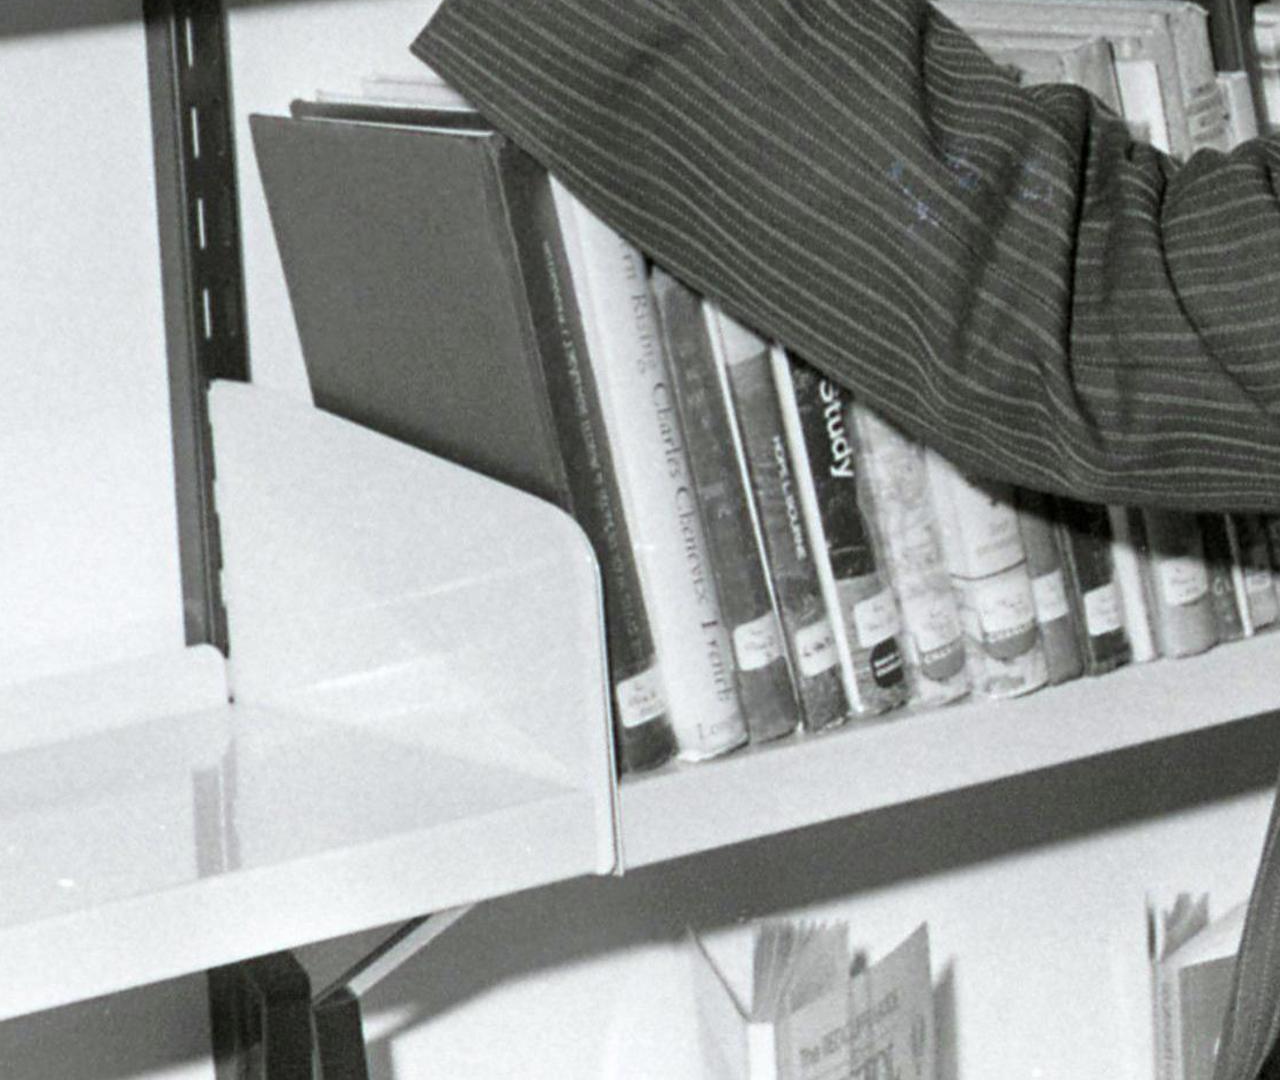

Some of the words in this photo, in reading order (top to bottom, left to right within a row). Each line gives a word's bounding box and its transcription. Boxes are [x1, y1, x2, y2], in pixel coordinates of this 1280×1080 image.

[652, 381, 684, 478] Charles
[674, 485, 710, 604] Chenevix
[819, 379, 856, 479] Study
